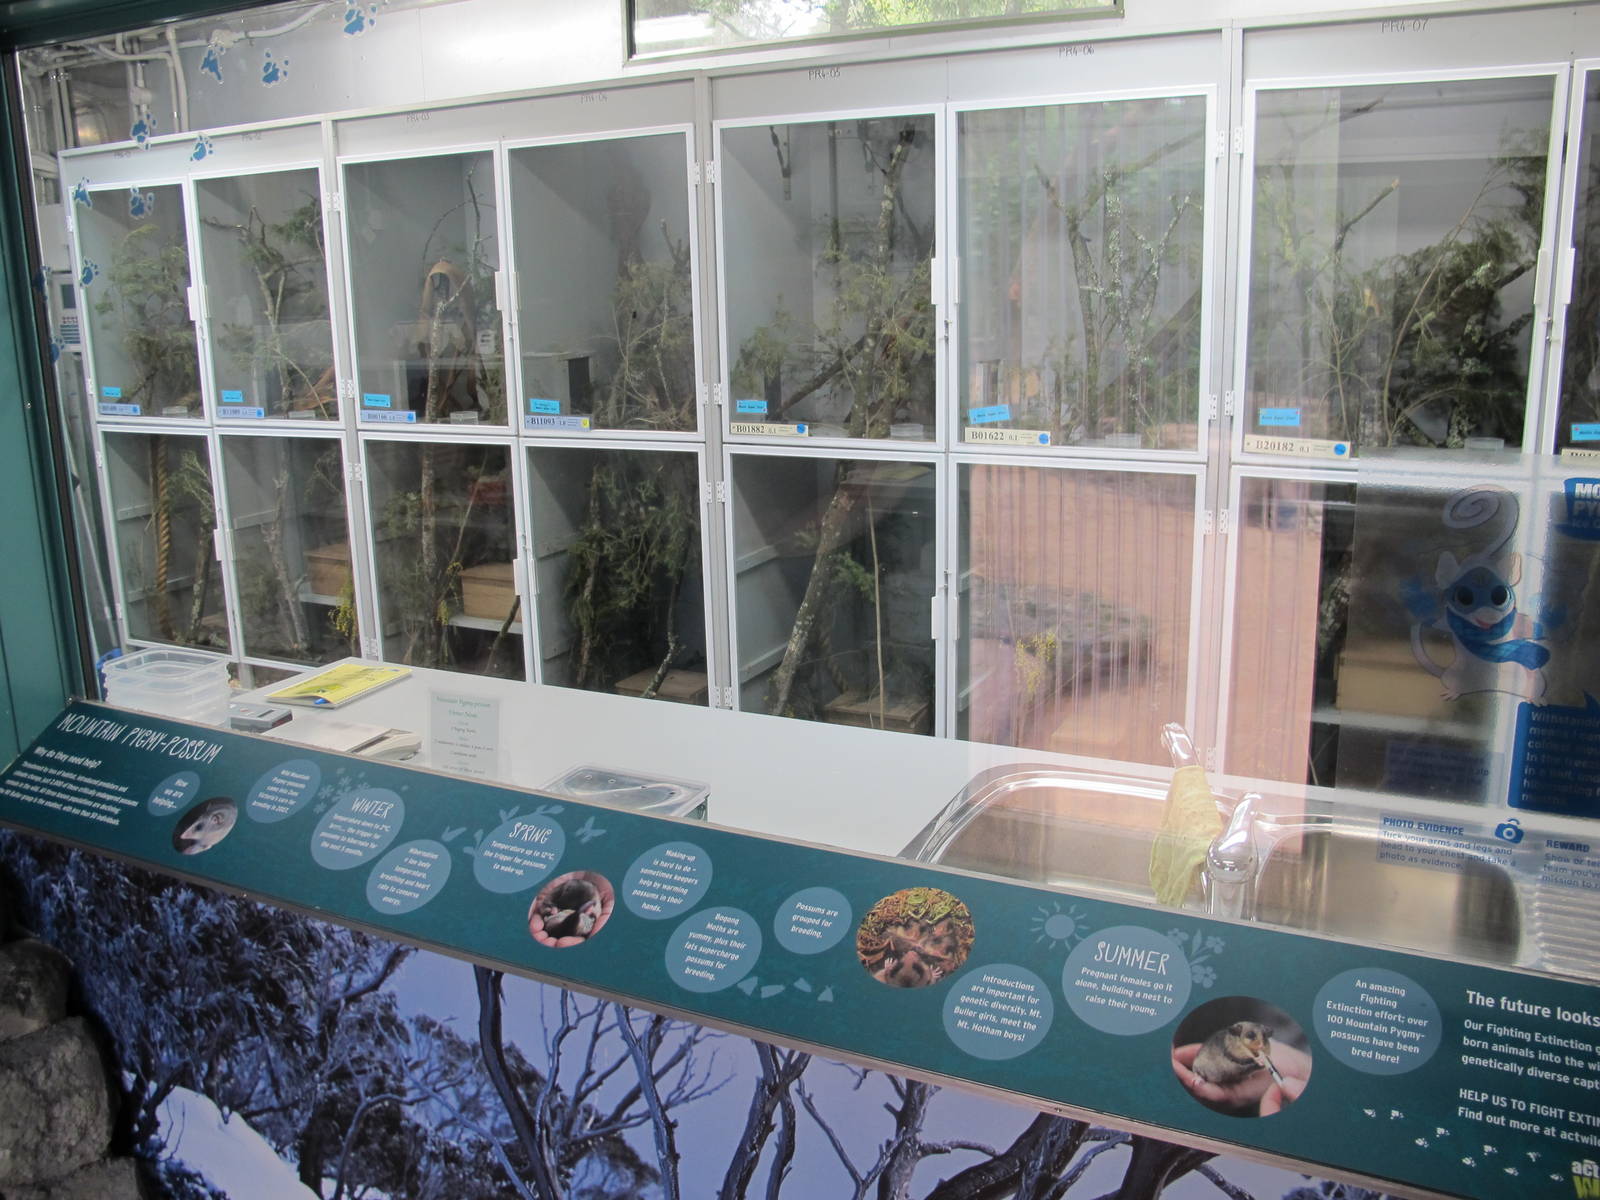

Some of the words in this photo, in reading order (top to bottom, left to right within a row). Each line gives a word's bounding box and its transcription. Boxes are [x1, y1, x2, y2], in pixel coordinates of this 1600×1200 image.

[971, 431, 1004, 440] B01622
[57, 713, 128, 742] MOUNTAIN
[122, 727, 223, 764] PYGMY-POSSUM
[352, 797, 395, 819] WINTER
[509, 822, 552, 844] SPRING
[1383, 817, 1414, 829] PHOTO
[1417, 822, 1465, 836] EVIDENCE
[1429, 839, 1451, 847] arms
[1454, 840, 1470, 849] and
[1473, 842, 1492, 854] legs
[1495, 847, 1512, 855] and
[1546, 840, 1590, 852] REWARD
[796, 902, 825, 914] Possums
[706, 922, 726, 933] Moths
[699, 946, 739, 960] supercharge
[729, 940, 747, 948] their
[685, 955, 714, 967] possums
[715, 961, 726, 969] for
[1094, 940, 1170, 975] SUMMER
[982, 974, 1035, 992] Introductions
[1081, 967, 1118, 981] Pregnant
[1119, 974, 1151, 988] females
[1153, 982, 1164, 990] go
[1166, 983, 1173, 992] it
[1355, 979, 1367, 988] An
[1369, 982, 1406, 997] amazing
[986, 987, 1025, 1001] important
[1027, 995, 1040, 1004] for
[1075, 979, 1099, 990] alone,
[1101, 984, 1134, 998] building
[1143, 992, 1162, 1002] nest
[1163, 996, 1173, 1004] to
[1360, 994, 1397, 1009] Fighting
[961, 995, 989, 1006] genetic
[991, 1000, 1027, 1017] diversity.
[1029, 1008, 1042, 1018] Mt.
[1085, 995, 1106, 1004] raise
[1108, 999, 1128, 1009] their
[1130, 1004, 1157, 1016] young.
[1326, 1001, 1372, 1017] Extinction
[1407, 1017, 1429, 1027] over
[1466, 989, 1495, 1007] The
[1500, 996, 1551, 1018] future
[1557, 1007, 1600, 1027] looks
[954, 1006, 977, 1017] Buller
[1000, 1017, 1022, 1027] meet
[1023, 1022, 1036, 1031] the
[1327, 1015, 1343, 1024] 100
[1345, 1018, 1388, 1033] Mountain
[1390, 1026, 1425, 1041] Pygmy-
[957, 1020, 969, 1029] Mt.
[972, 1023, 1002, 1036] Hotham
[1004, 1030, 1025, 1042] boys!
[1330, 1030, 1370, 1044] possums
[1372, 1037, 1394, 1048] have
[1397, 1042, 1419, 1054] been
[1464, 1019, 1484, 1031] Our
[1487, 1023, 1531, 1042] Fighting
[1534, 1033, 1592, 1052] Extinction
[1351, 1047, 1373, 1058] bred
[1375, 1052, 1400, 1064] here!
[1463, 1036, 1489, 1049] born
[1491, 1042, 1535, 1059] animals
[1538, 1050, 1561, 1064] into
[1565, 1055, 1584, 1068] the
[1461, 1054, 1524, 1076] genetically
[1527, 1066, 1570, 1083] diverse
[1459, 1088, 1489, 1103] HELP
[1492, 1095, 1508, 1107] US
[1510, 1099, 1526, 1111] TO
[1529, 1103, 1565, 1120] FIGHT
[1458, 1107, 1483, 1121] Find
[1486, 1115, 1506, 1126] out
[1509, 1119, 1540, 1133] more
[1544, 1127, 1557, 1137] at
